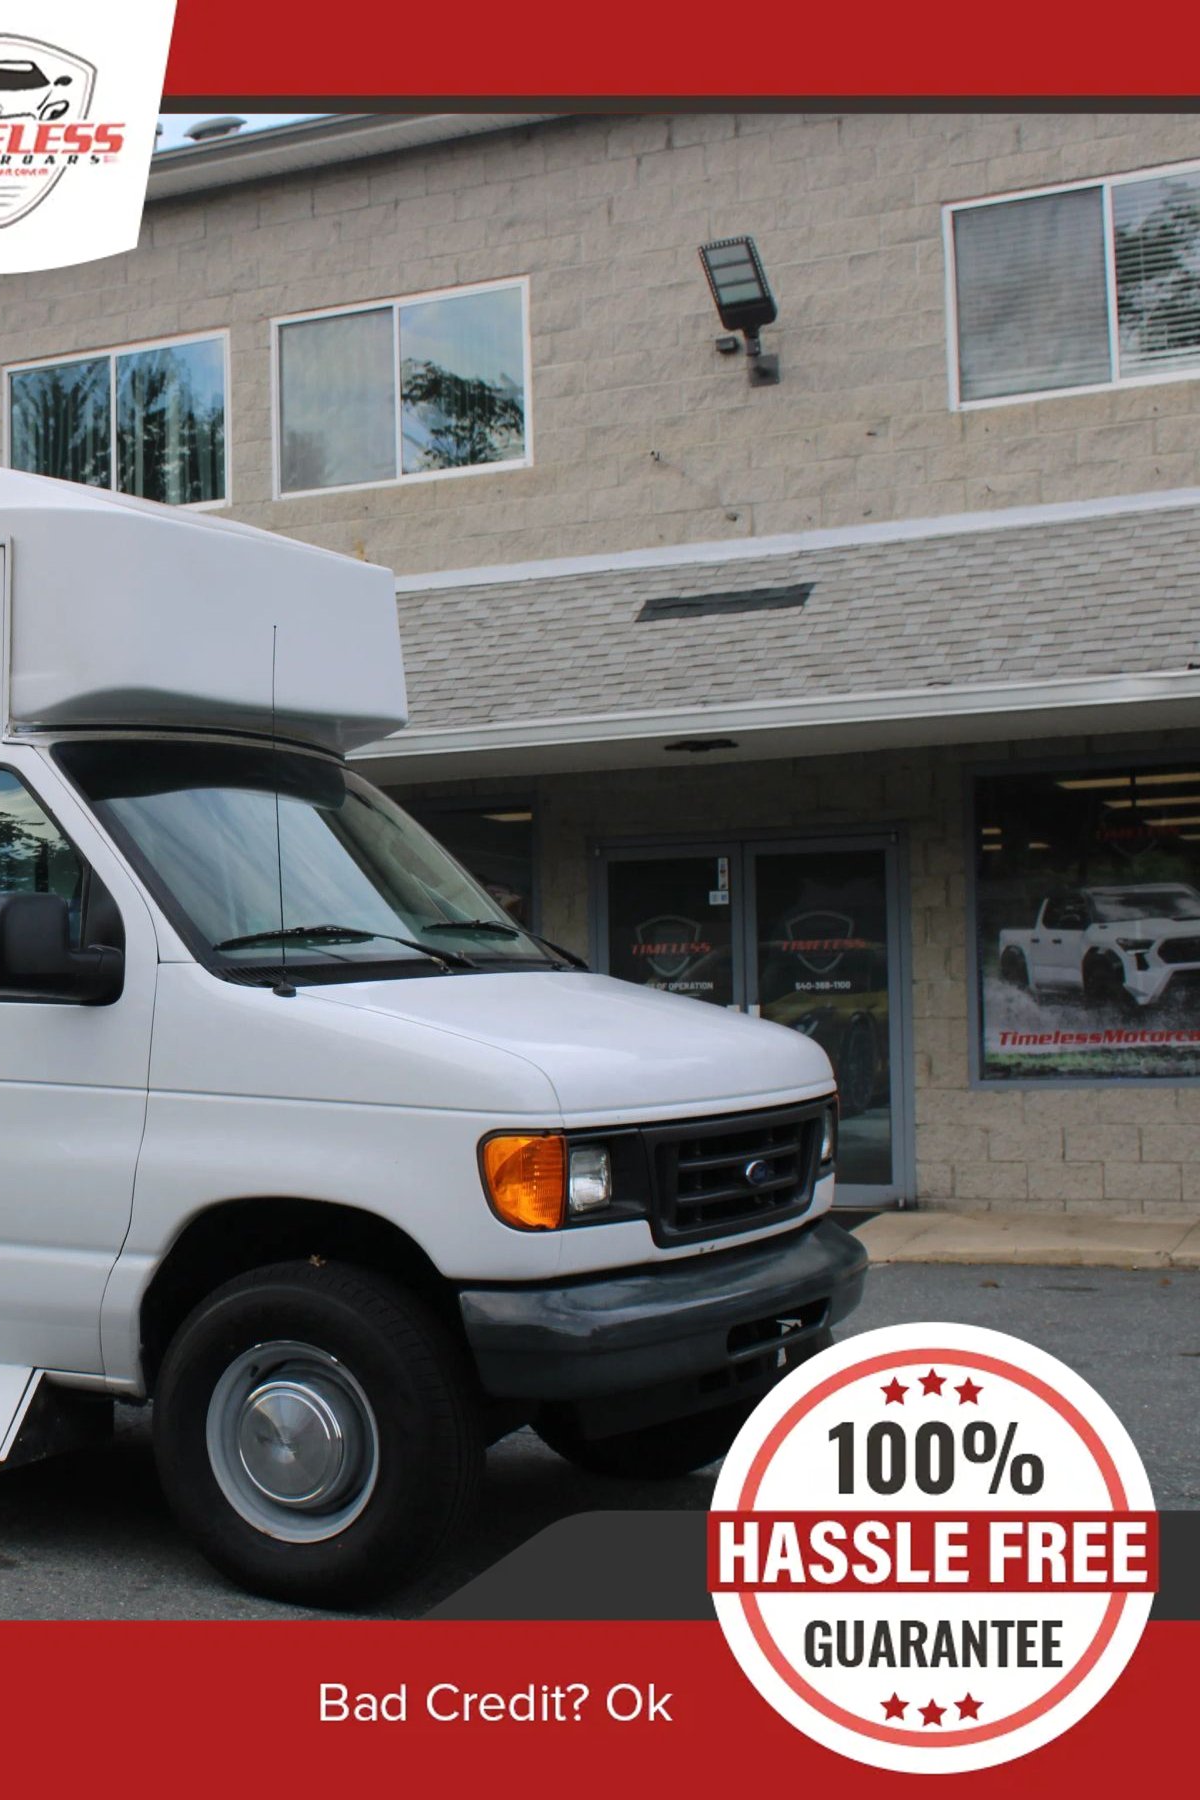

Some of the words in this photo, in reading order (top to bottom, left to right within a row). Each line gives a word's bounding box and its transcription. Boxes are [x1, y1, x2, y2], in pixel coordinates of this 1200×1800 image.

[631, 941, 711, 956] TIMELESS
[780, 938, 867, 952] TIMELESS
[668, 981, 714, 991] OPERATION
